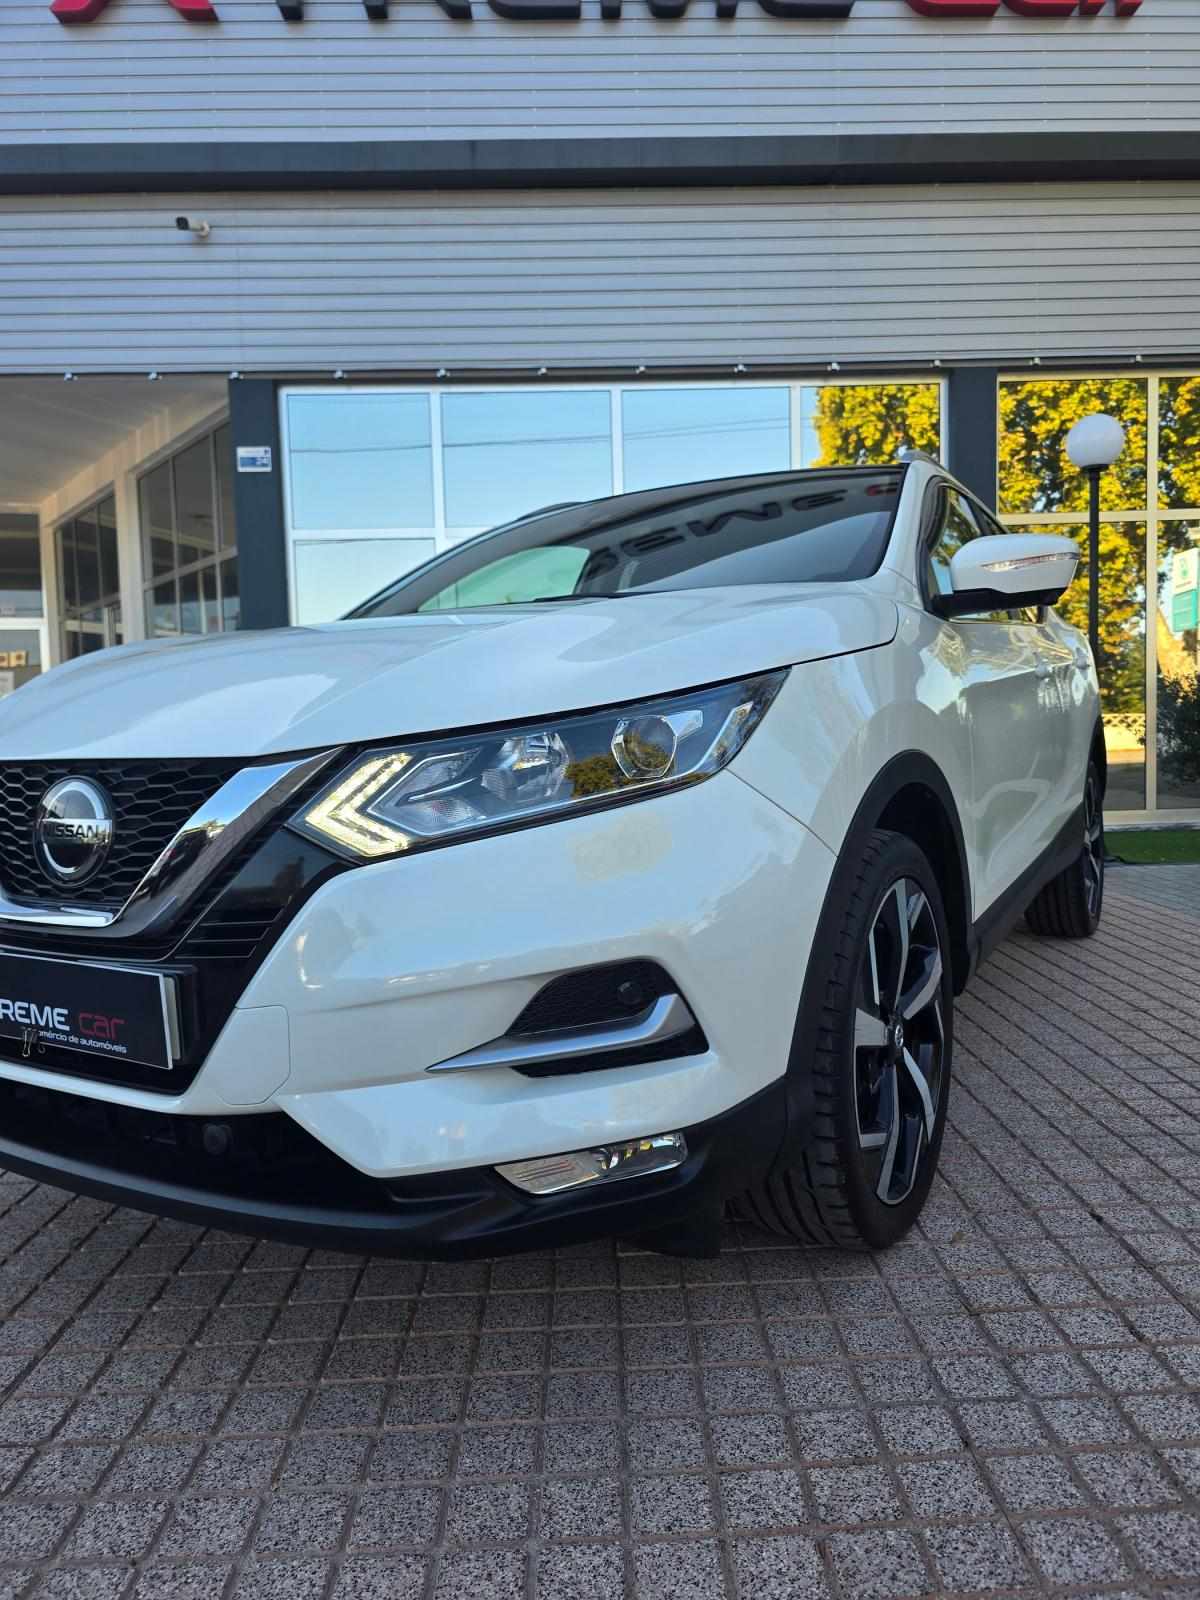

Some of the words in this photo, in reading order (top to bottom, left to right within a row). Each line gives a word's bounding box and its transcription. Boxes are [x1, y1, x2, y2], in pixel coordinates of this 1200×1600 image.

[0, 998, 70, 1031] REME
[79, 1012, 126, 1040] car
[68, 1035, 79, 1044] de
